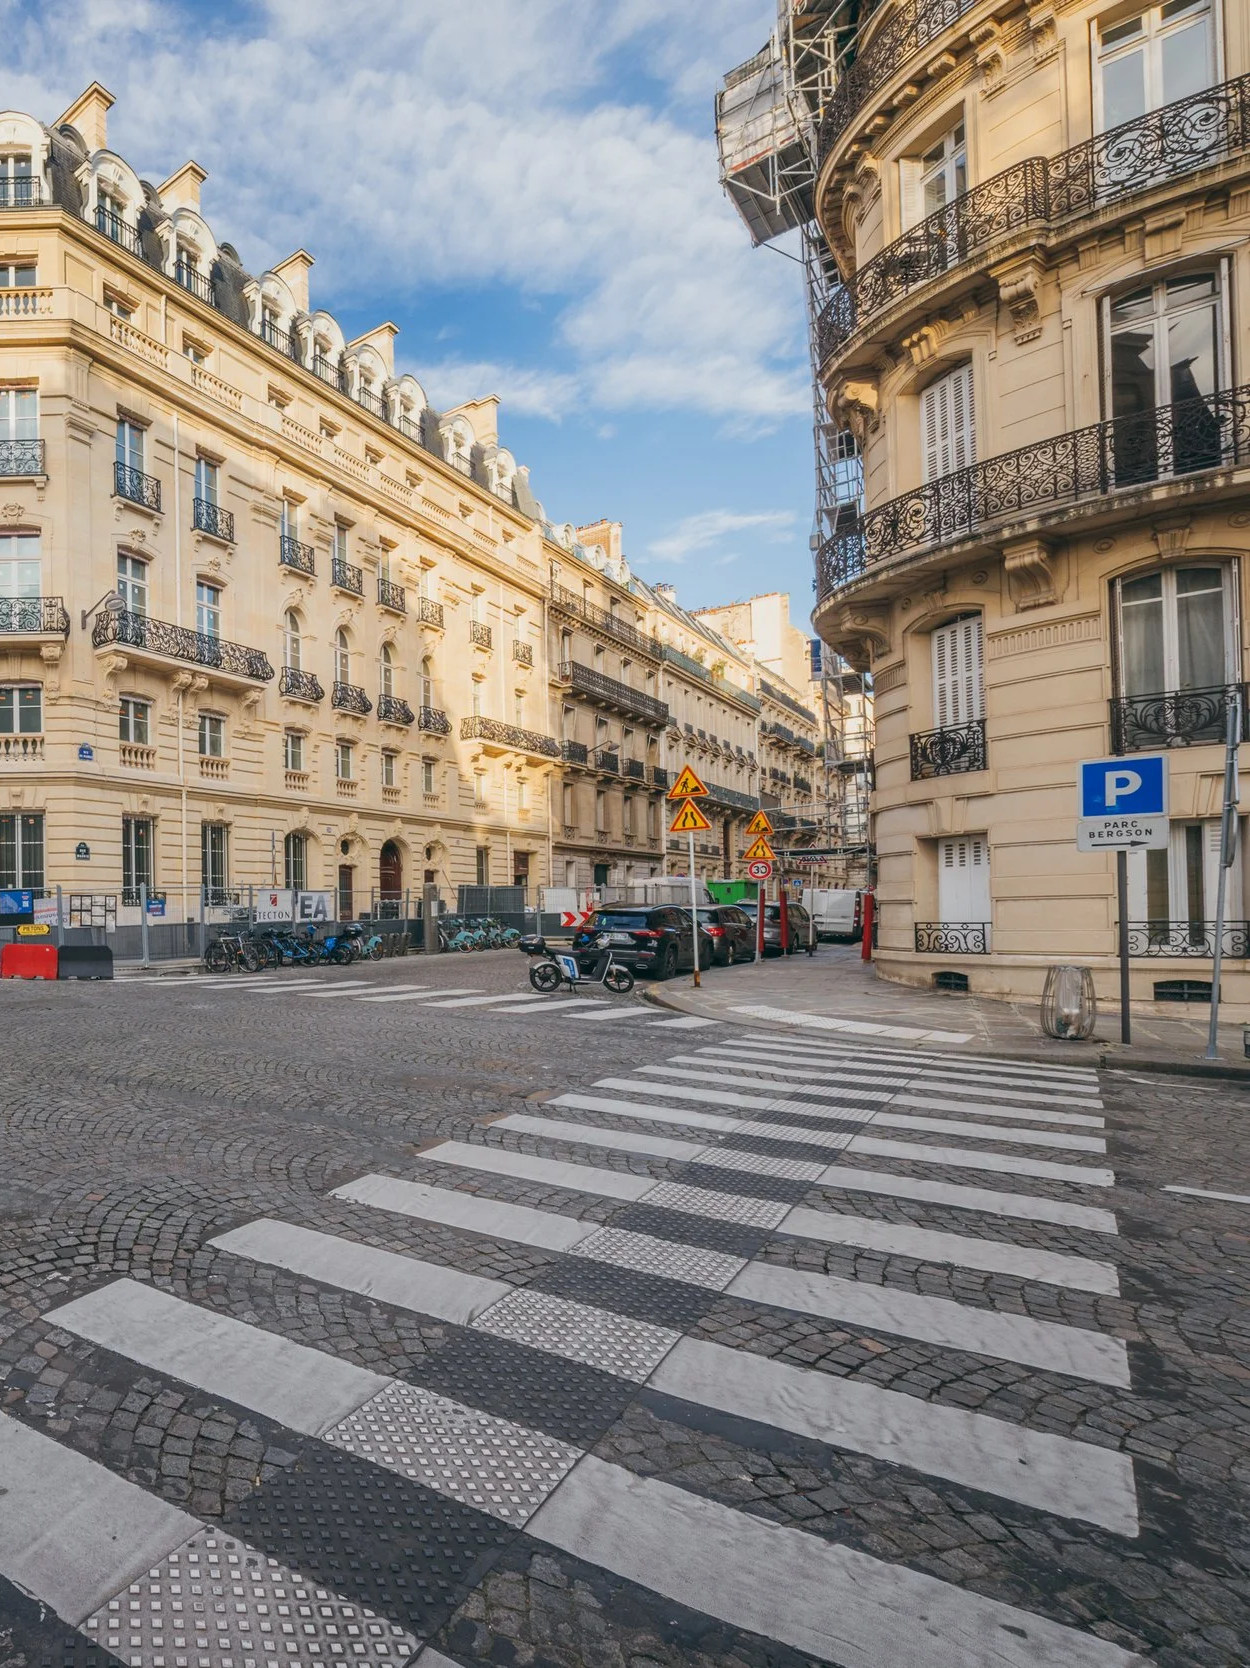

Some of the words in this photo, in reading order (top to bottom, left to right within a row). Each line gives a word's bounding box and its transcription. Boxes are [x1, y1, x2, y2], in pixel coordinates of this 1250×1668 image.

[1105, 770, 1142, 807] P
[1104, 820, 1138, 829] PARC
[1089, 828, 1153, 839] BERGSON
[753, 865, 768, 875] 30
[258, 911, 290, 920] TECTON
